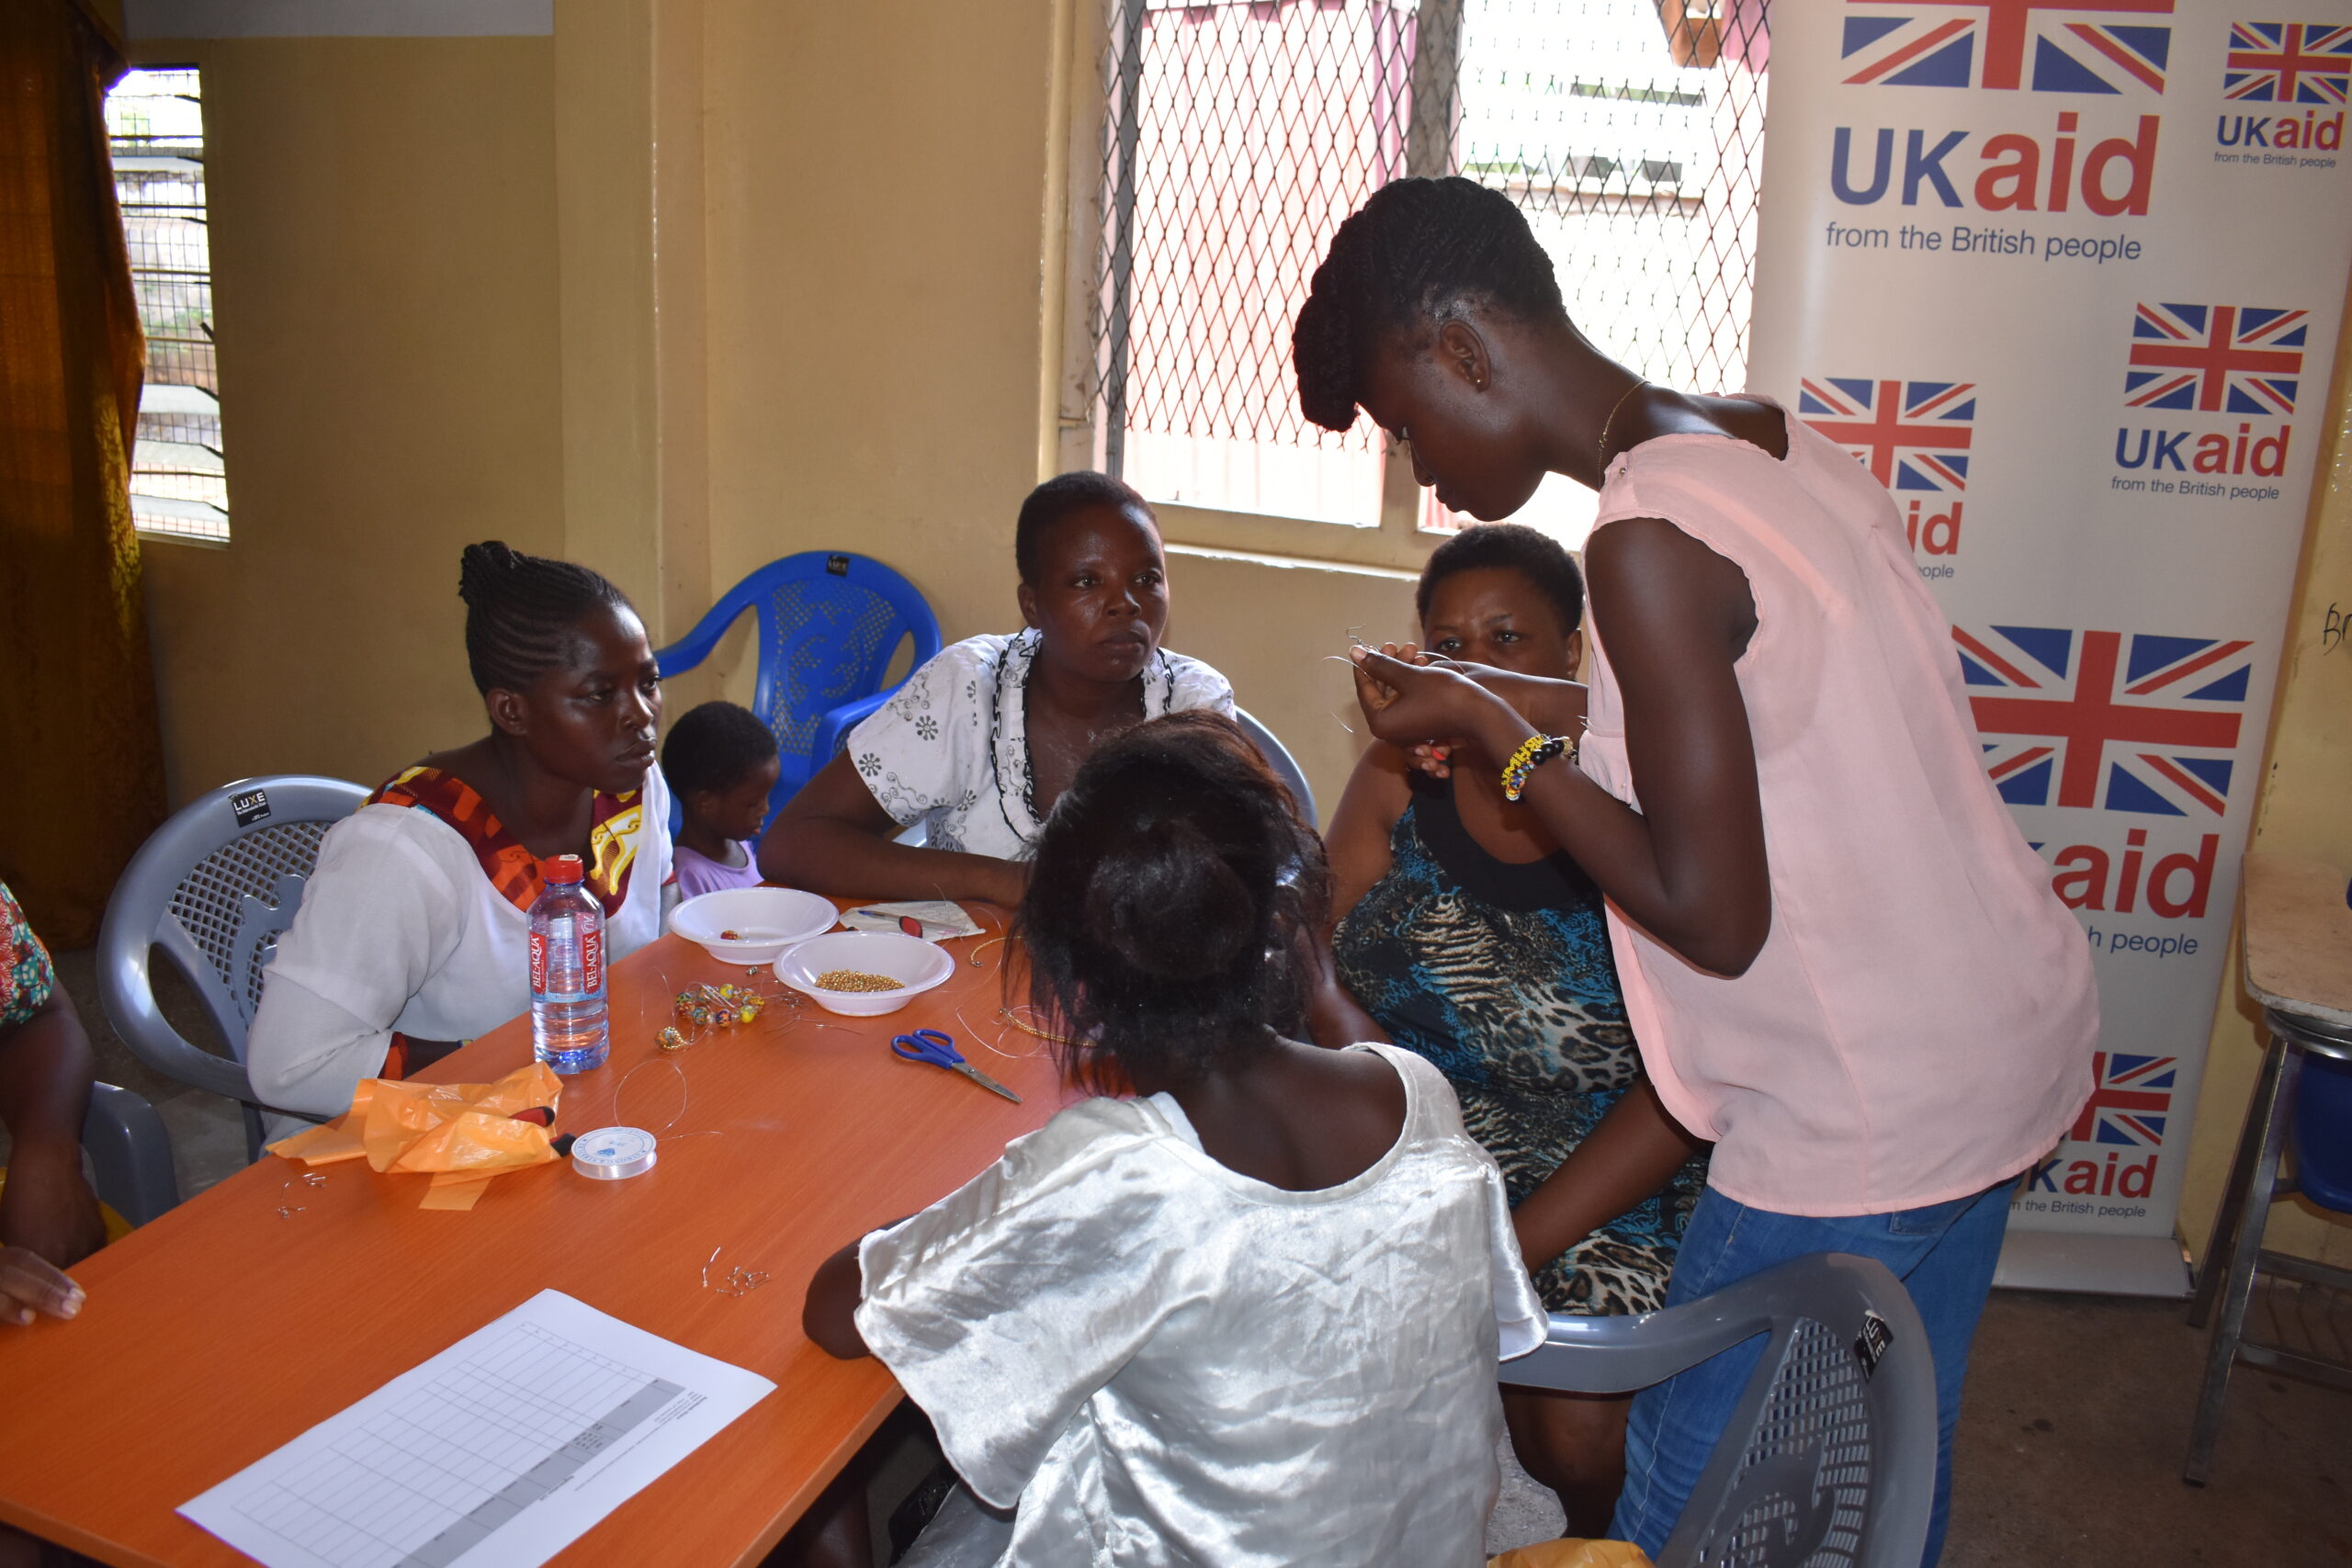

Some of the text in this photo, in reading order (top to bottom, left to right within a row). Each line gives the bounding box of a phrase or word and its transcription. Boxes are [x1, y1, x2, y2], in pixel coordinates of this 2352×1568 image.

[2214, 152, 2336, 169] from the British people
[1826, 221, 2142, 265] from the British people
[2111, 476, 2279, 502] from the British people
[1917, 563, 1954, 581] ople
[232, 792, 266, 811] LUXE
[2028, 828, 2220, 919] aid
[2110, 933, 2199, 958] people
[2025, 1200, 2047, 1212] the
[2051, 1201, 2094, 1213] British
[2098, 1205, 2146, 1219] people
